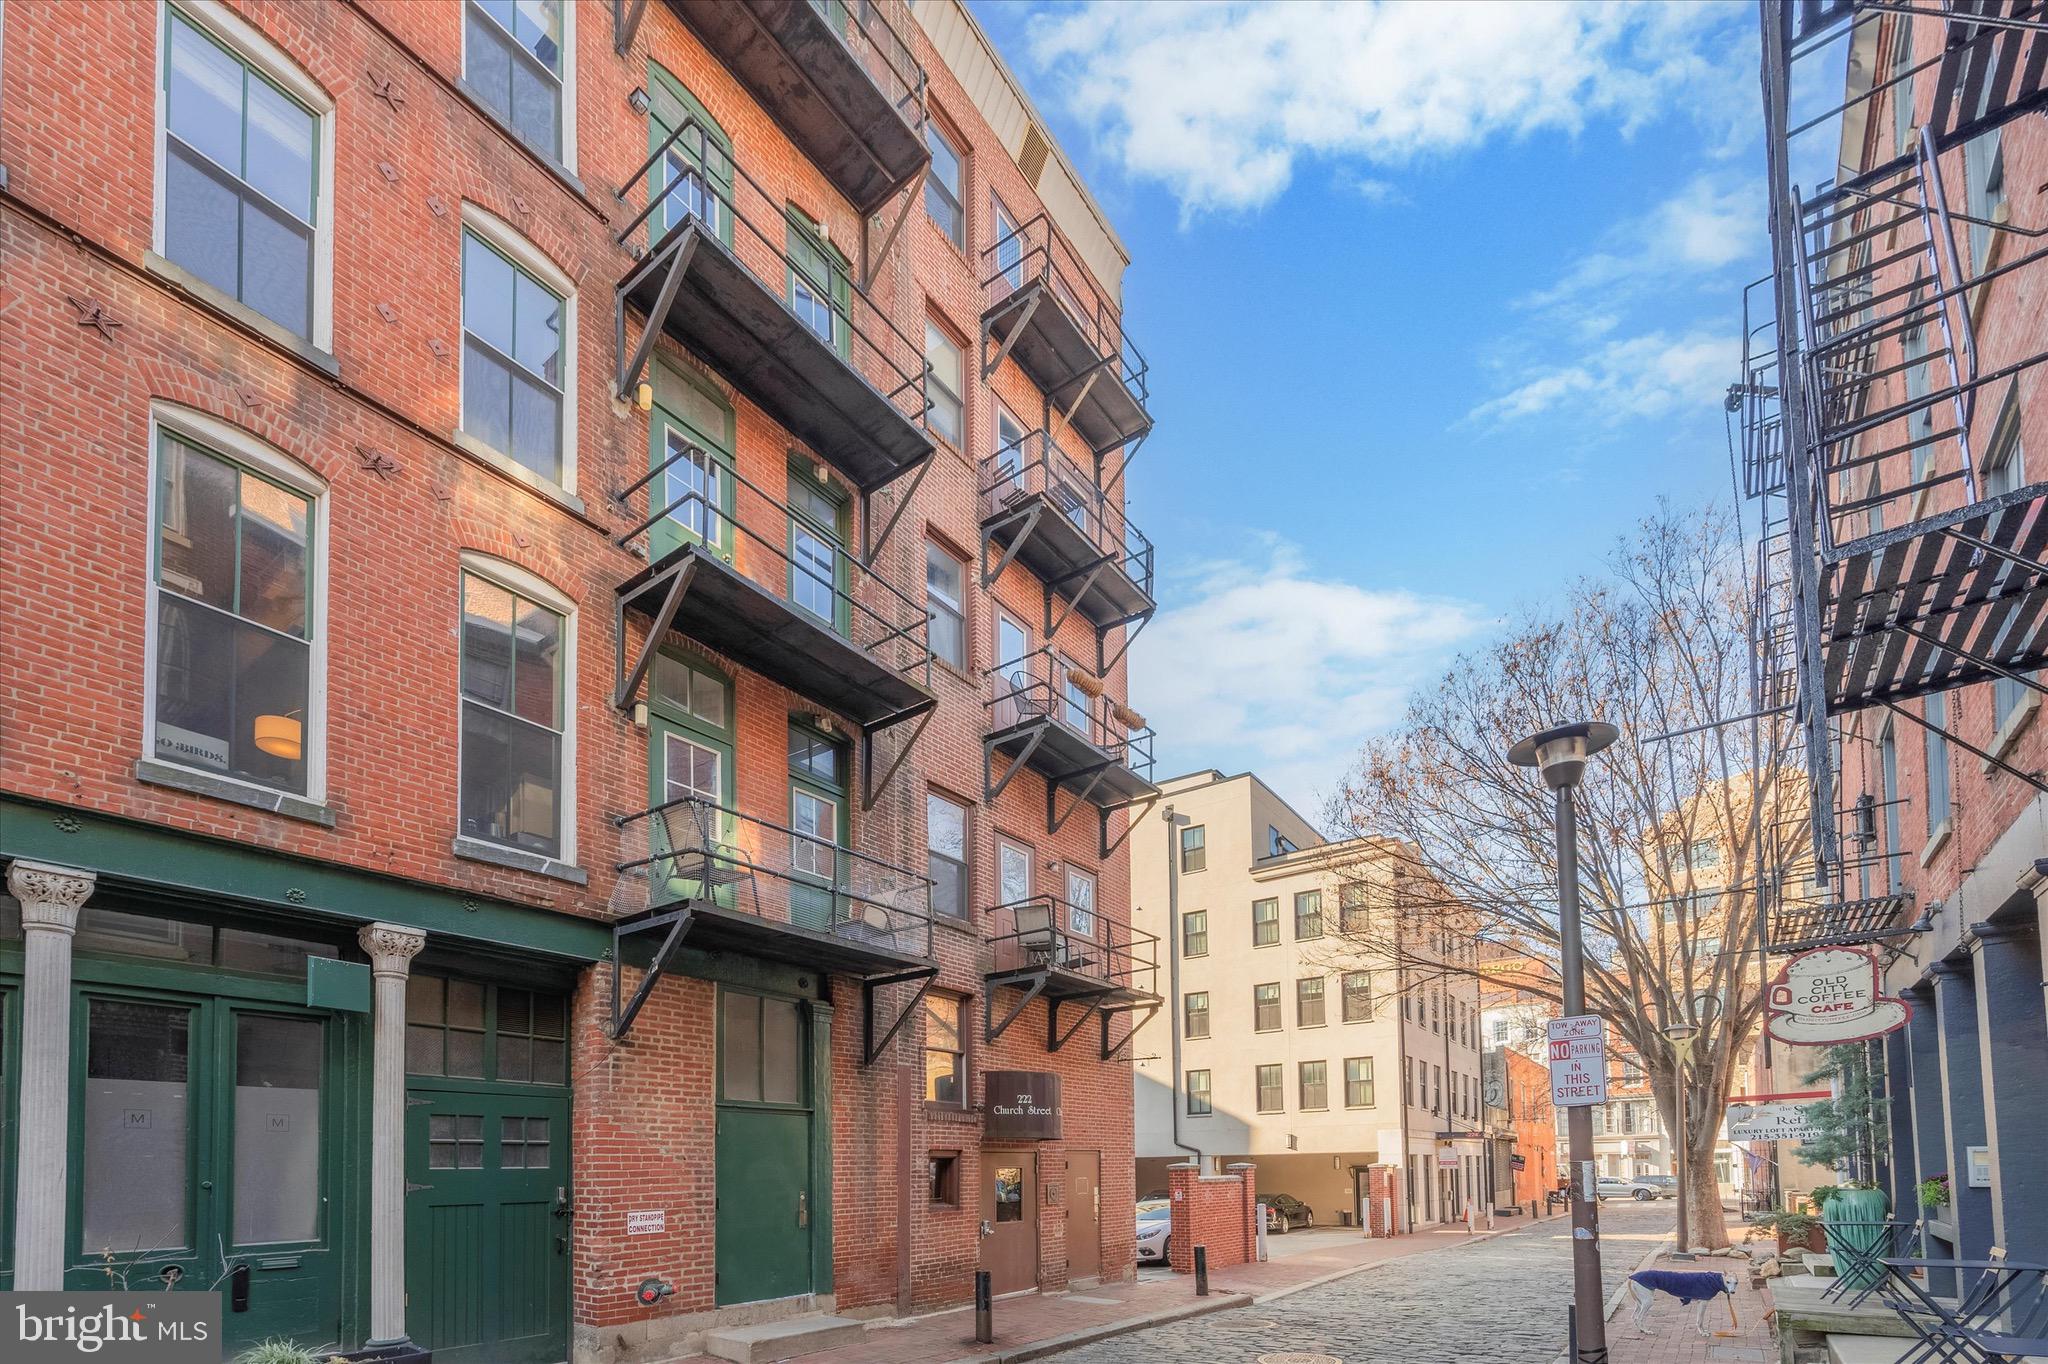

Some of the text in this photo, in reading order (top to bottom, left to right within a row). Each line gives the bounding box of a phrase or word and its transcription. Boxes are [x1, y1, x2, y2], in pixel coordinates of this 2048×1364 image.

[1812, 975, 1847, 987] OLD
[1811, 983, 1849, 995] CITY
[1797, 989, 1866, 1004] COFFEE
[1811, 1002, 1854, 1013] CAFE
[1551, 1022, 1568, 1030] TOW
[1575, 1018, 1597, 1027] AWAY
[1564, 1029, 1585, 1037] ZONE
[1550, 1043, 1600, 1060] NO PARKING
[1571, 1063, 1581, 1071] IN
[1564, 1073, 1590, 1085] THIS
[1557, 1085, 1600, 1098] STREET
[1016, 1094, 1032, 1104] 222
[993, 1105, 1024, 1115] Church
[1027, 1105, 1051, 1115] Street
[131, 1114, 145, 1123] M
[272, 1118, 284, 1128] M
[639, 1213, 664, 1221] STANDPIPE
[628, 1223, 664, 1233] CONNECTION
